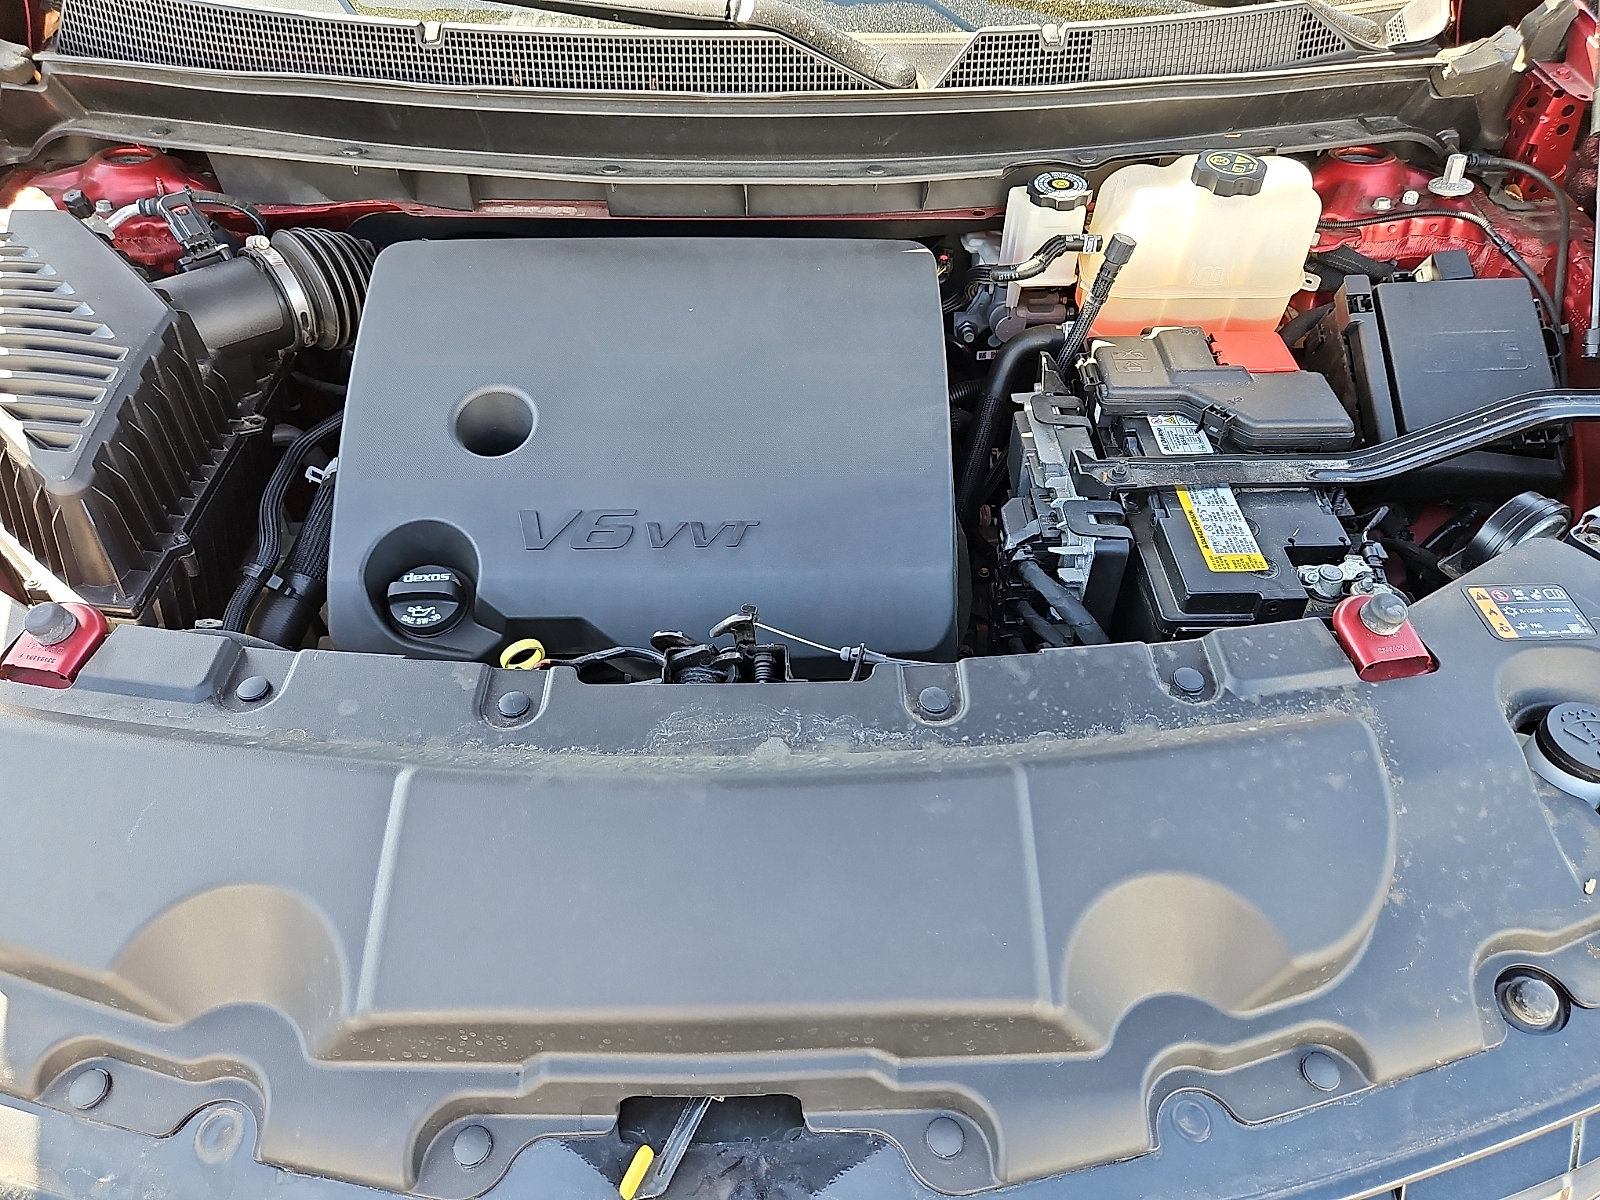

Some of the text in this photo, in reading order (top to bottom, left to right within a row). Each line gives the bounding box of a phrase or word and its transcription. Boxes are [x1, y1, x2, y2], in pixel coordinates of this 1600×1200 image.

[518, 508, 760, 551] V6 VVT
[403, 572, 452, 583] dexos
[401, 614, 415, 624] SAE
